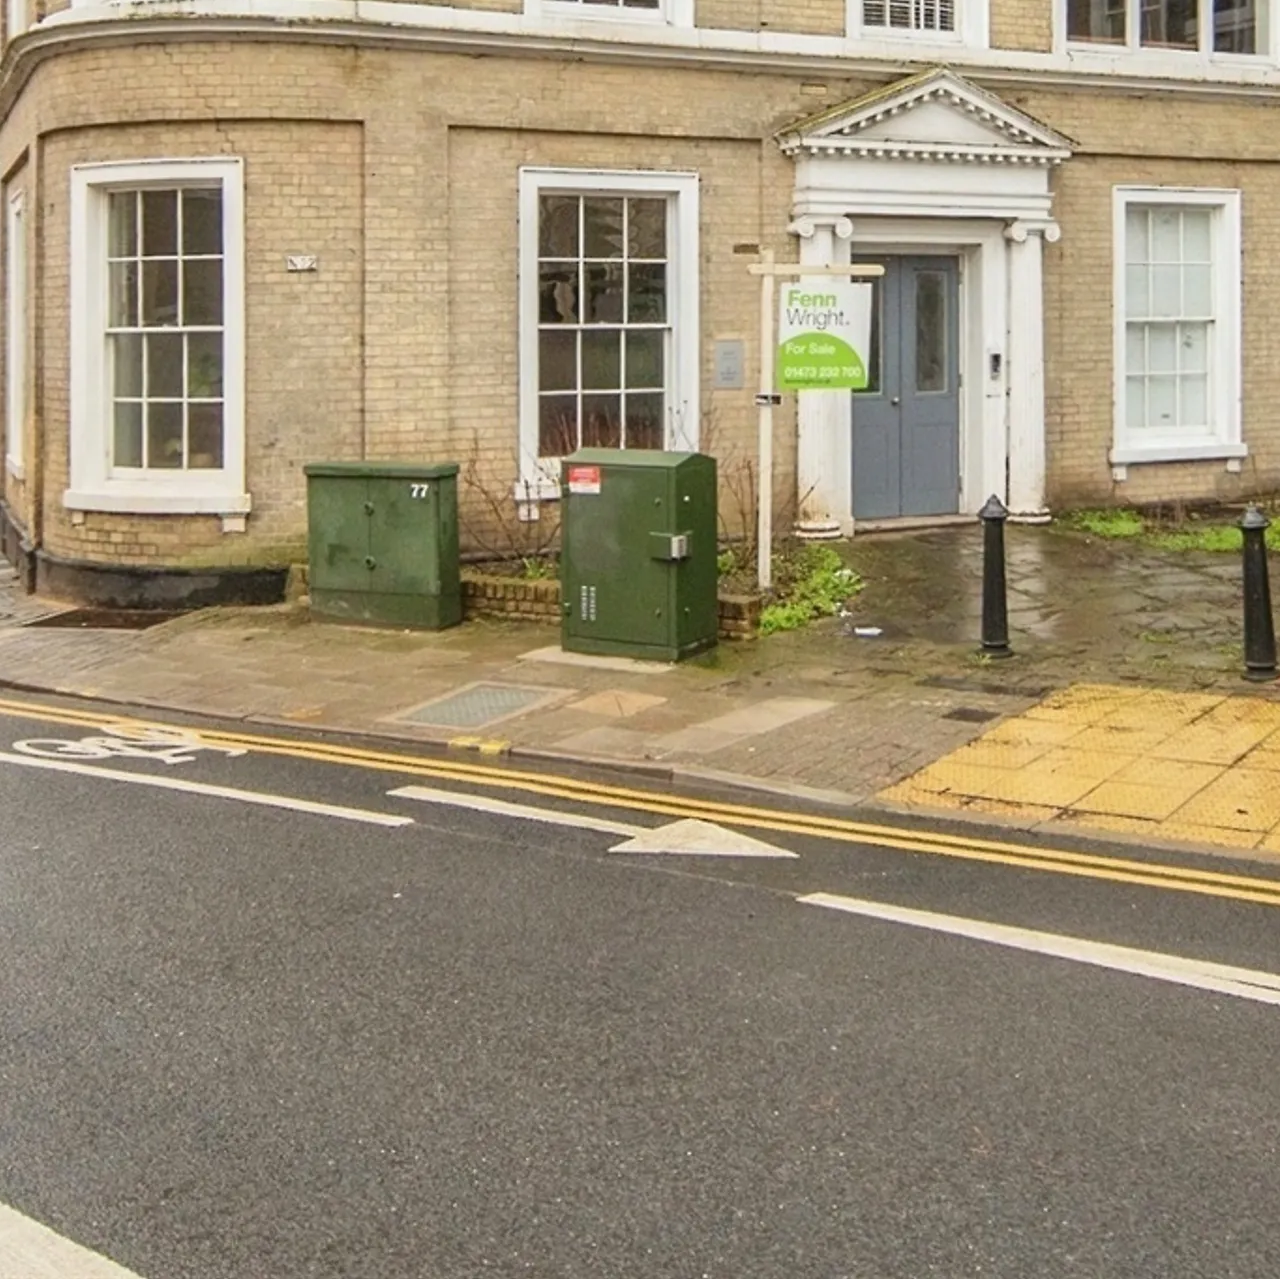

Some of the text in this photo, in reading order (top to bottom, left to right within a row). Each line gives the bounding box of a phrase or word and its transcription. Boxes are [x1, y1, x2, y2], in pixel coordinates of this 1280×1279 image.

[787, 289, 837, 307] Fenn
[785, 342, 836, 355] For Sale
[411, 483, 428, 498] 77
